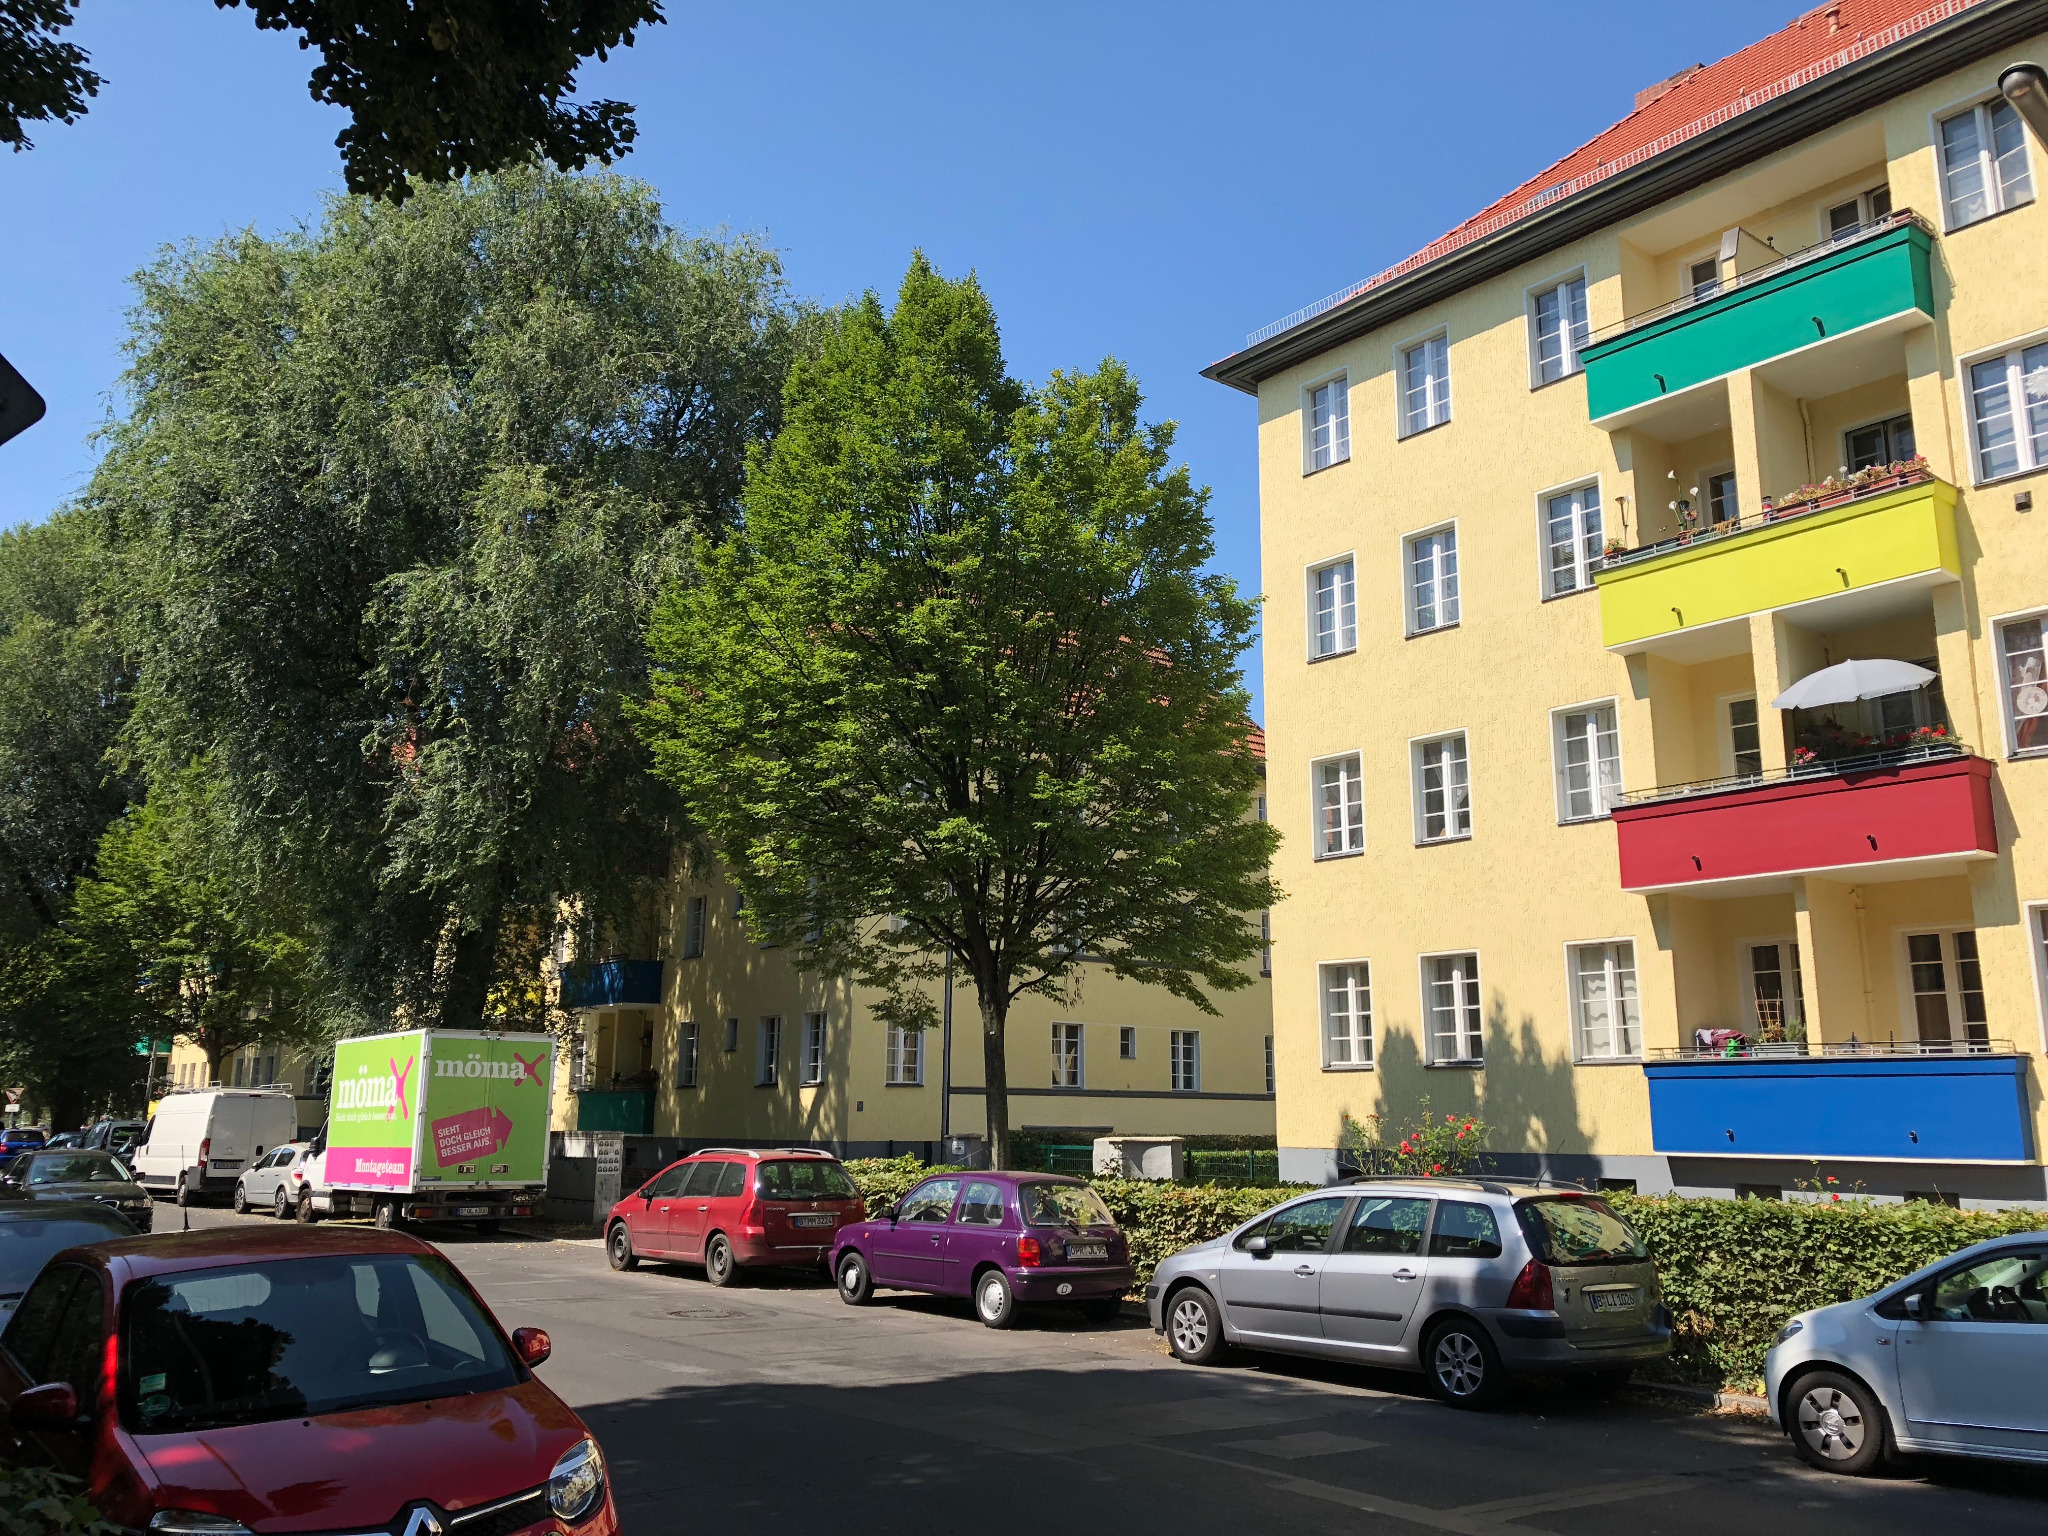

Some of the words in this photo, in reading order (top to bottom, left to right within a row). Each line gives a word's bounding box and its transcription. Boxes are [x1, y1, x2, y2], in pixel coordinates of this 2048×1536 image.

[438, 1124, 460, 1138] SIEHT
[440, 1134, 462, 1147] DOCH
[463, 1126, 491, 1141] GLEICH
[441, 1142, 471, 1157] BESSER
[473, 1137, 492, 1149] AUS.
[355, 1158, 404, 1178] Montageteam
